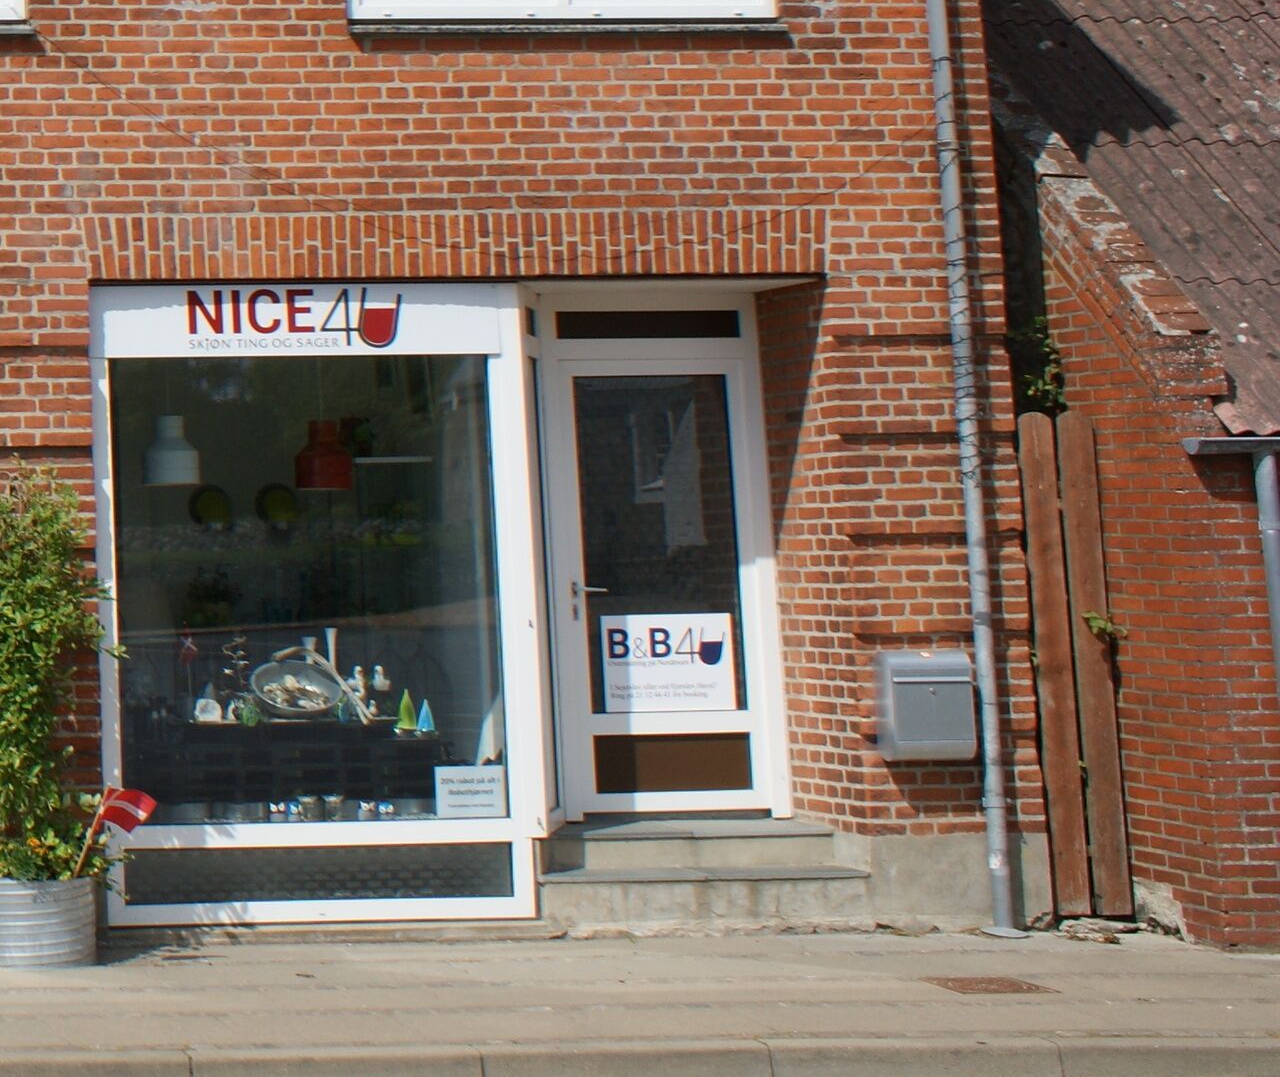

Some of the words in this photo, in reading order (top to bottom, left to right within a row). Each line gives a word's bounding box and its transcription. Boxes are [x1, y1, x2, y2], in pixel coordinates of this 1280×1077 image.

[237, 338, 269, 350] TING
[271, 338, 293, 349] OG
[297, 337, 340, 349] SAGER
